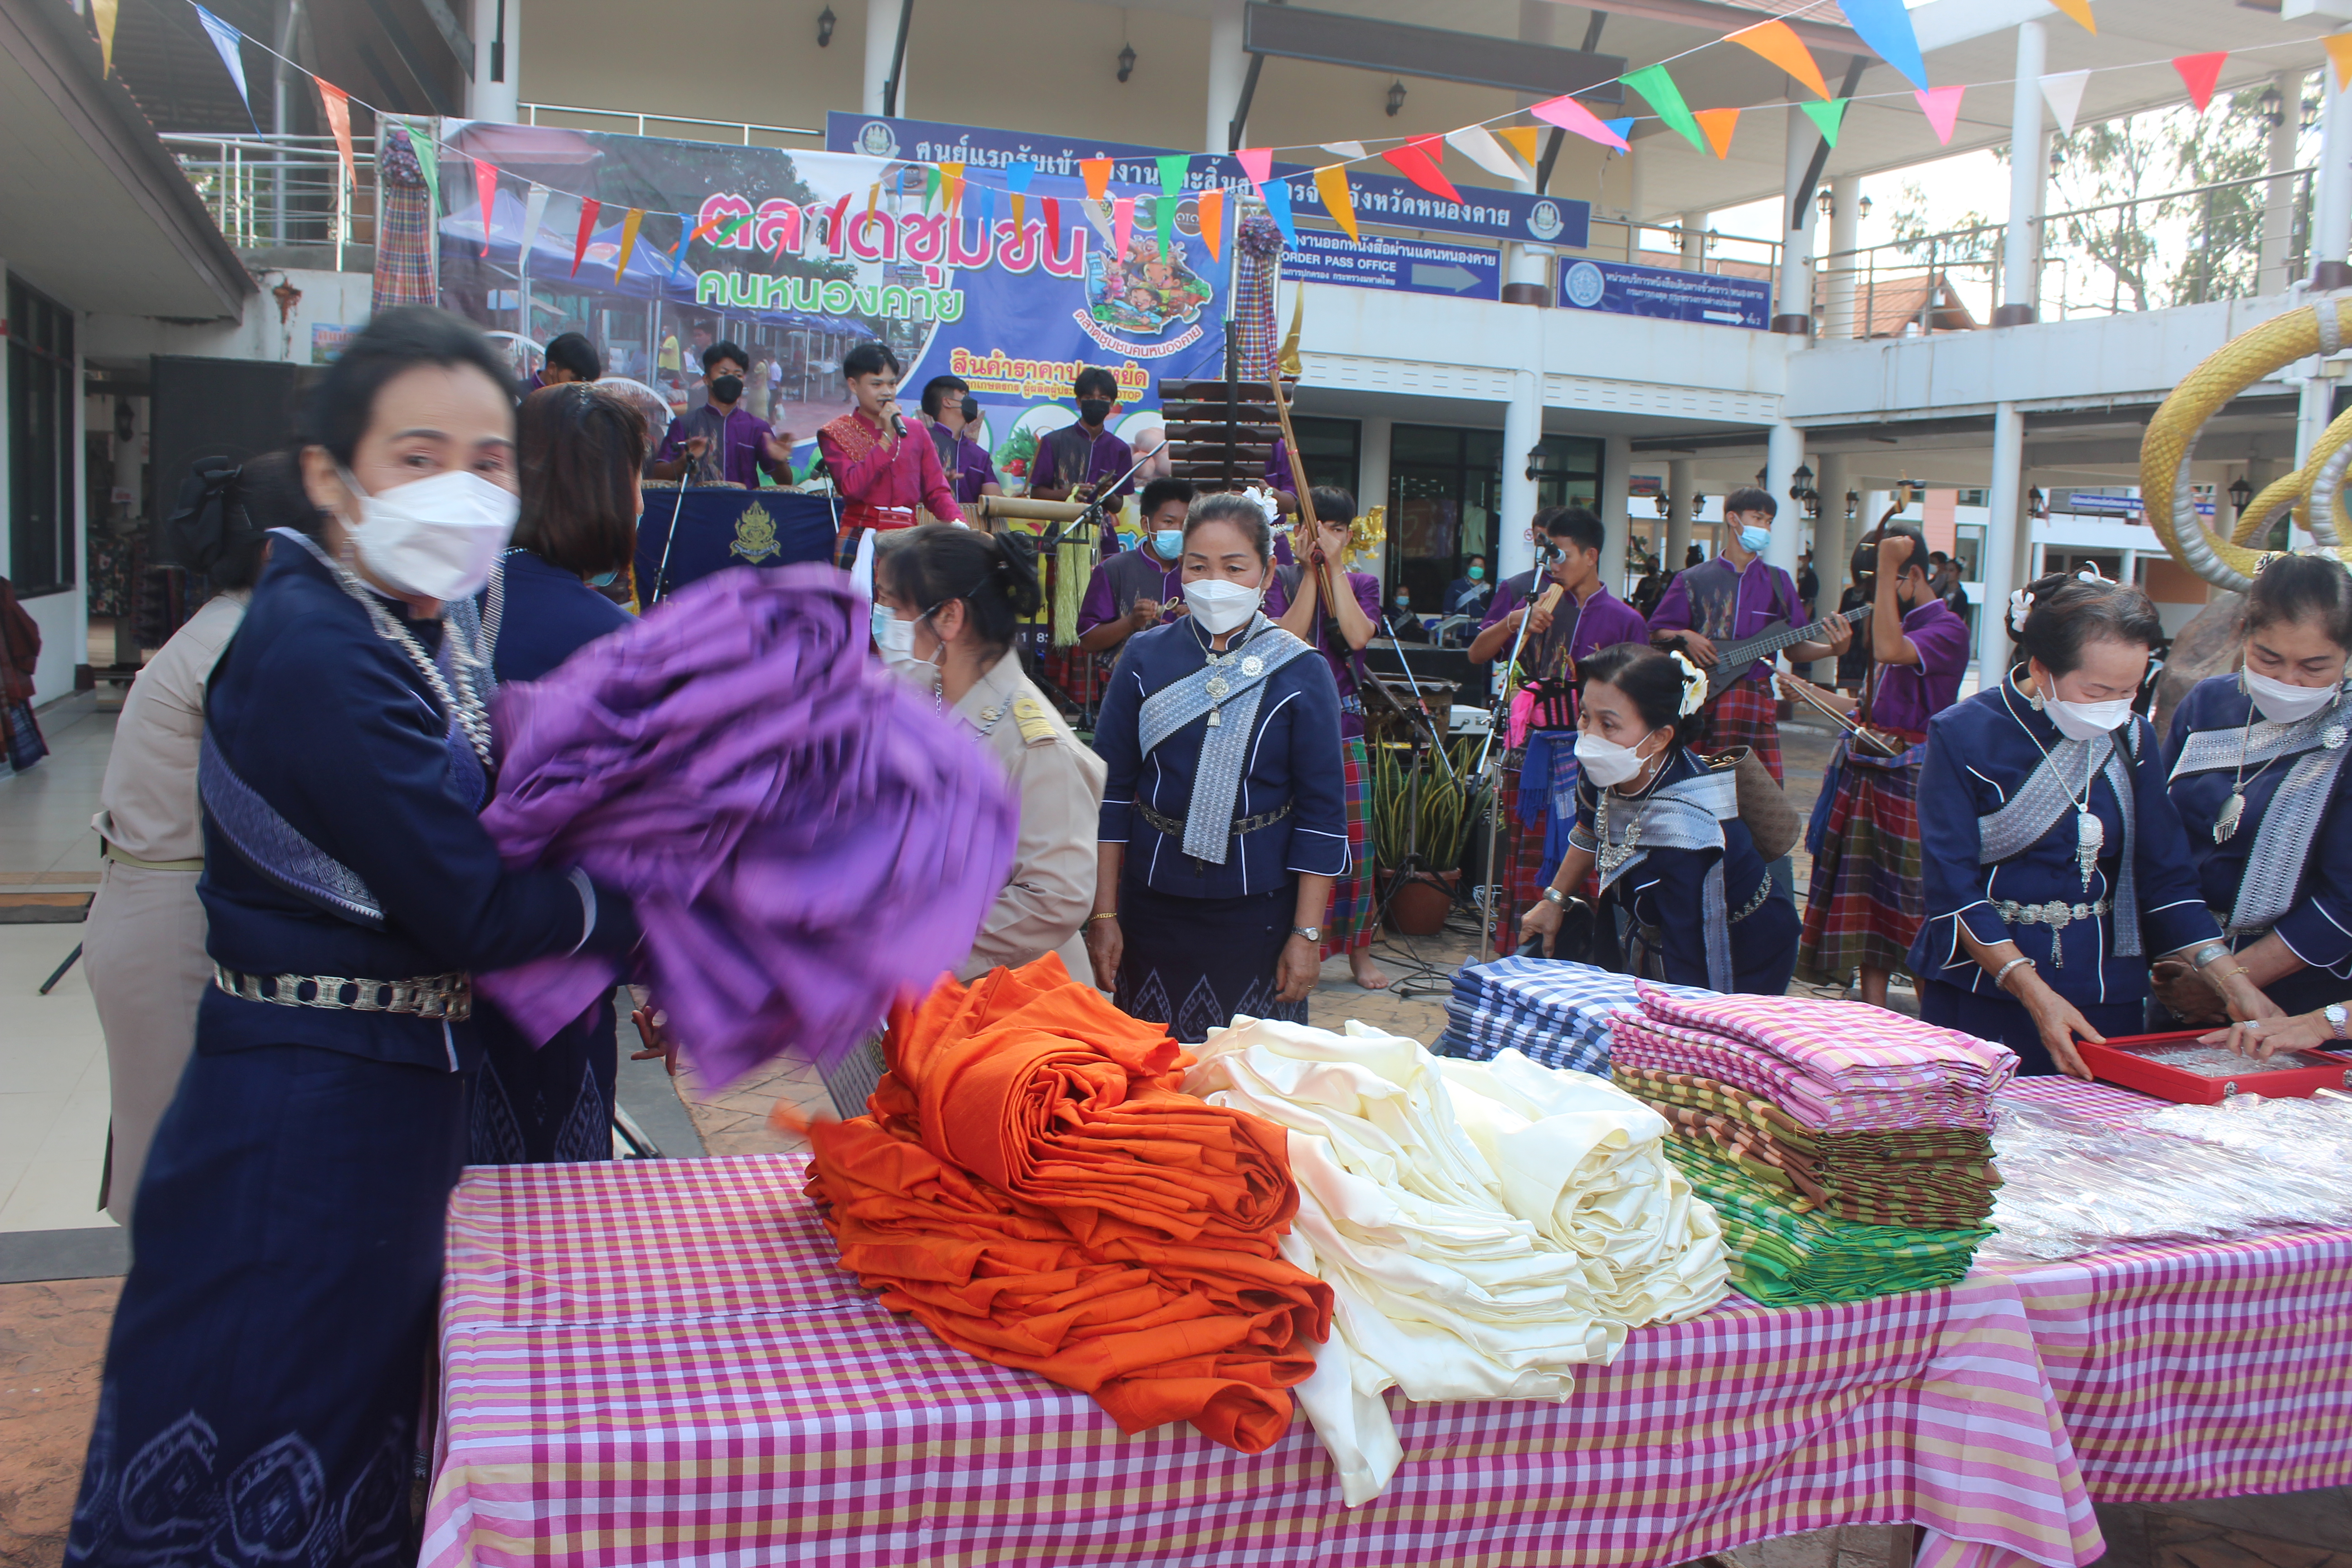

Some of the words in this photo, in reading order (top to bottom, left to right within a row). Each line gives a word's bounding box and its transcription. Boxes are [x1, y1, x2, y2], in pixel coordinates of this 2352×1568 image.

[1176, 213, 1199, 222] OTO
[1281, 250, 1321, 265] ORDER
[1325, 255, 1354, 268] PASS
[1357, 259, 1396, 272] OFFICE
[696, 270, 963, 321] คนหนองคาย
[1074, 310, 1202, 357] ตลาดชุมชนคนหนองคาย
[952, 351, 1147, 386] สินค้าราคาปหยัด
